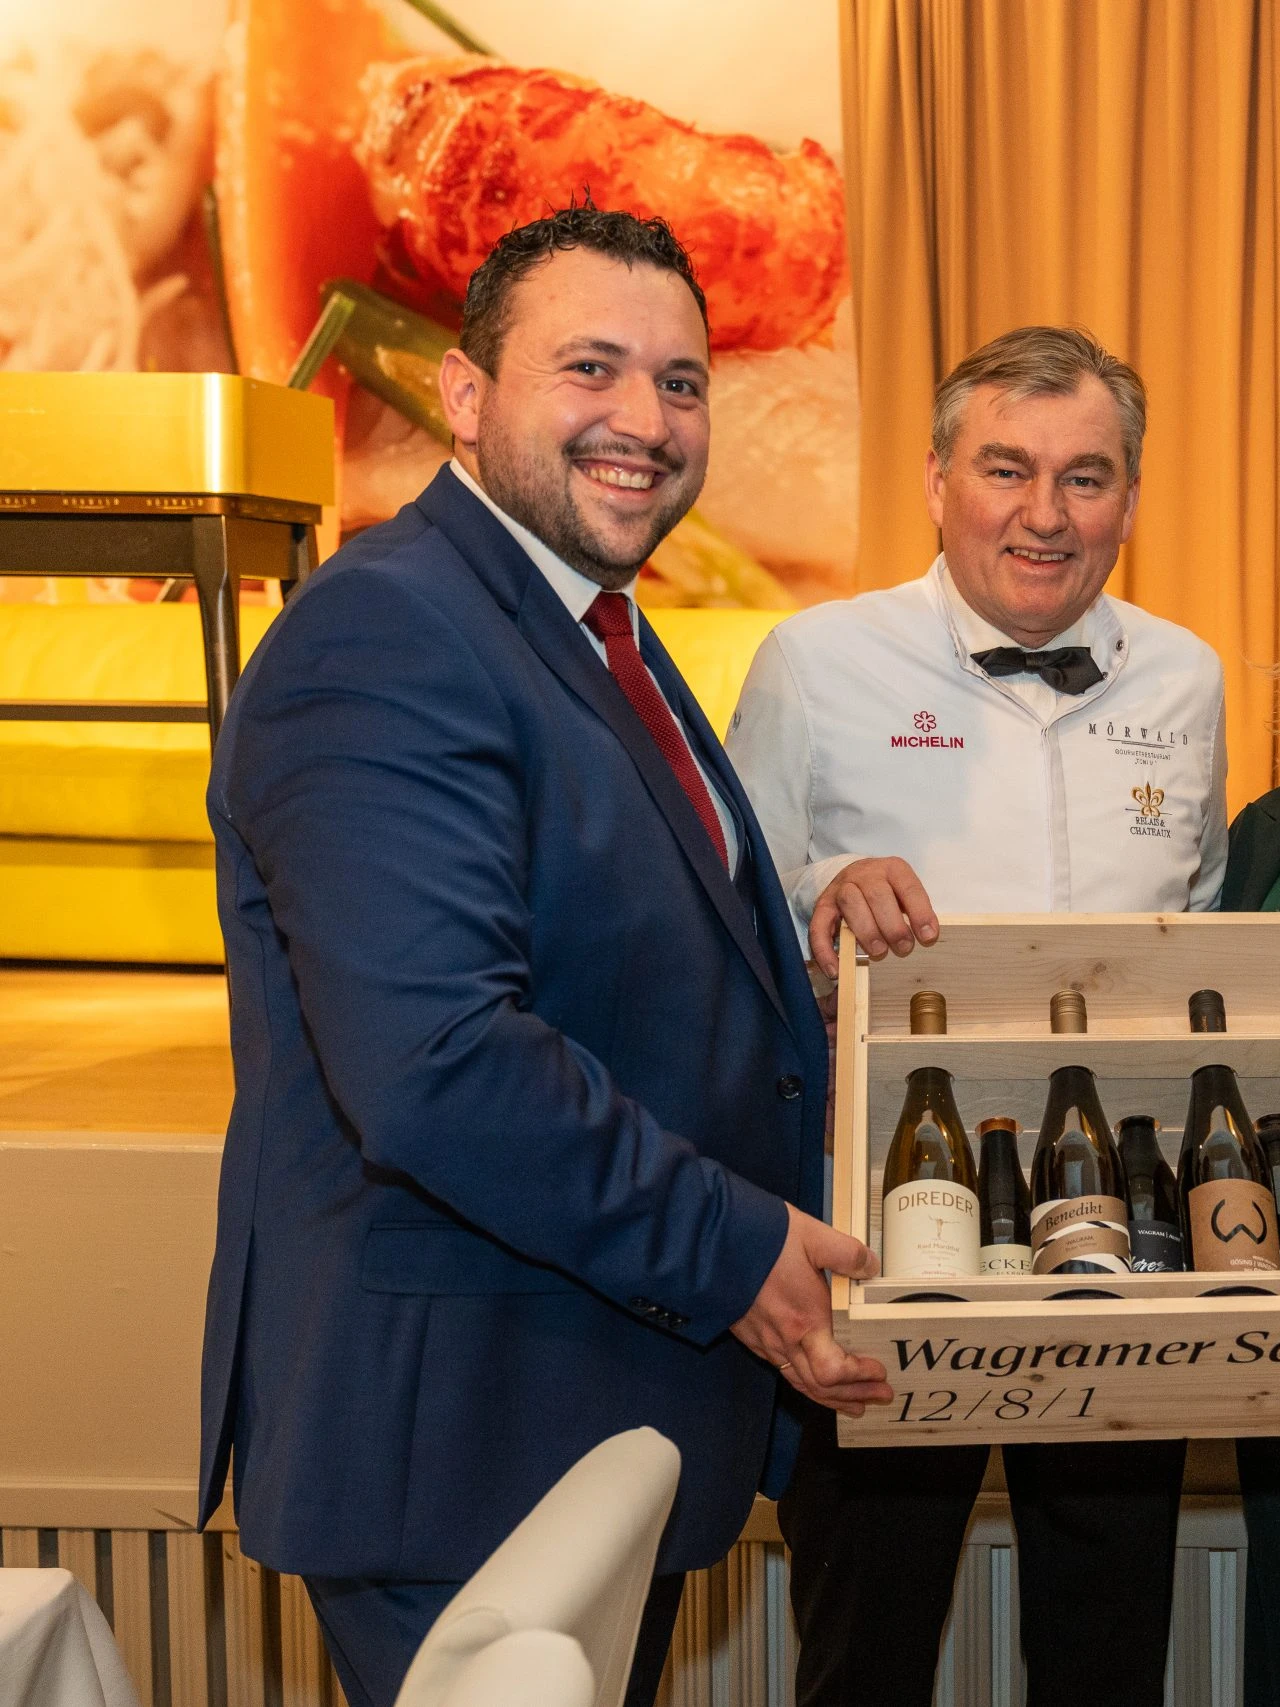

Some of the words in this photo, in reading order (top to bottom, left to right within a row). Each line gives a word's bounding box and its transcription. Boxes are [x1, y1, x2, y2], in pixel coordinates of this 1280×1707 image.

[891, 735, 964, 749] MICHELIN
[1129, 826, 1171, 838] CHATEAUX
[898, 1191, 974, 1217] DIREDER
[1045, 1201, 1104, 1231] Benedikt
[1137, 1229, 1166, 1238] WAGRAM
[980, 1258, 1031, 1273] ECKE
[889, 1337, 1216, 1378] Wagramer
[888, 1386, 1097, 1423] 12/8/1
